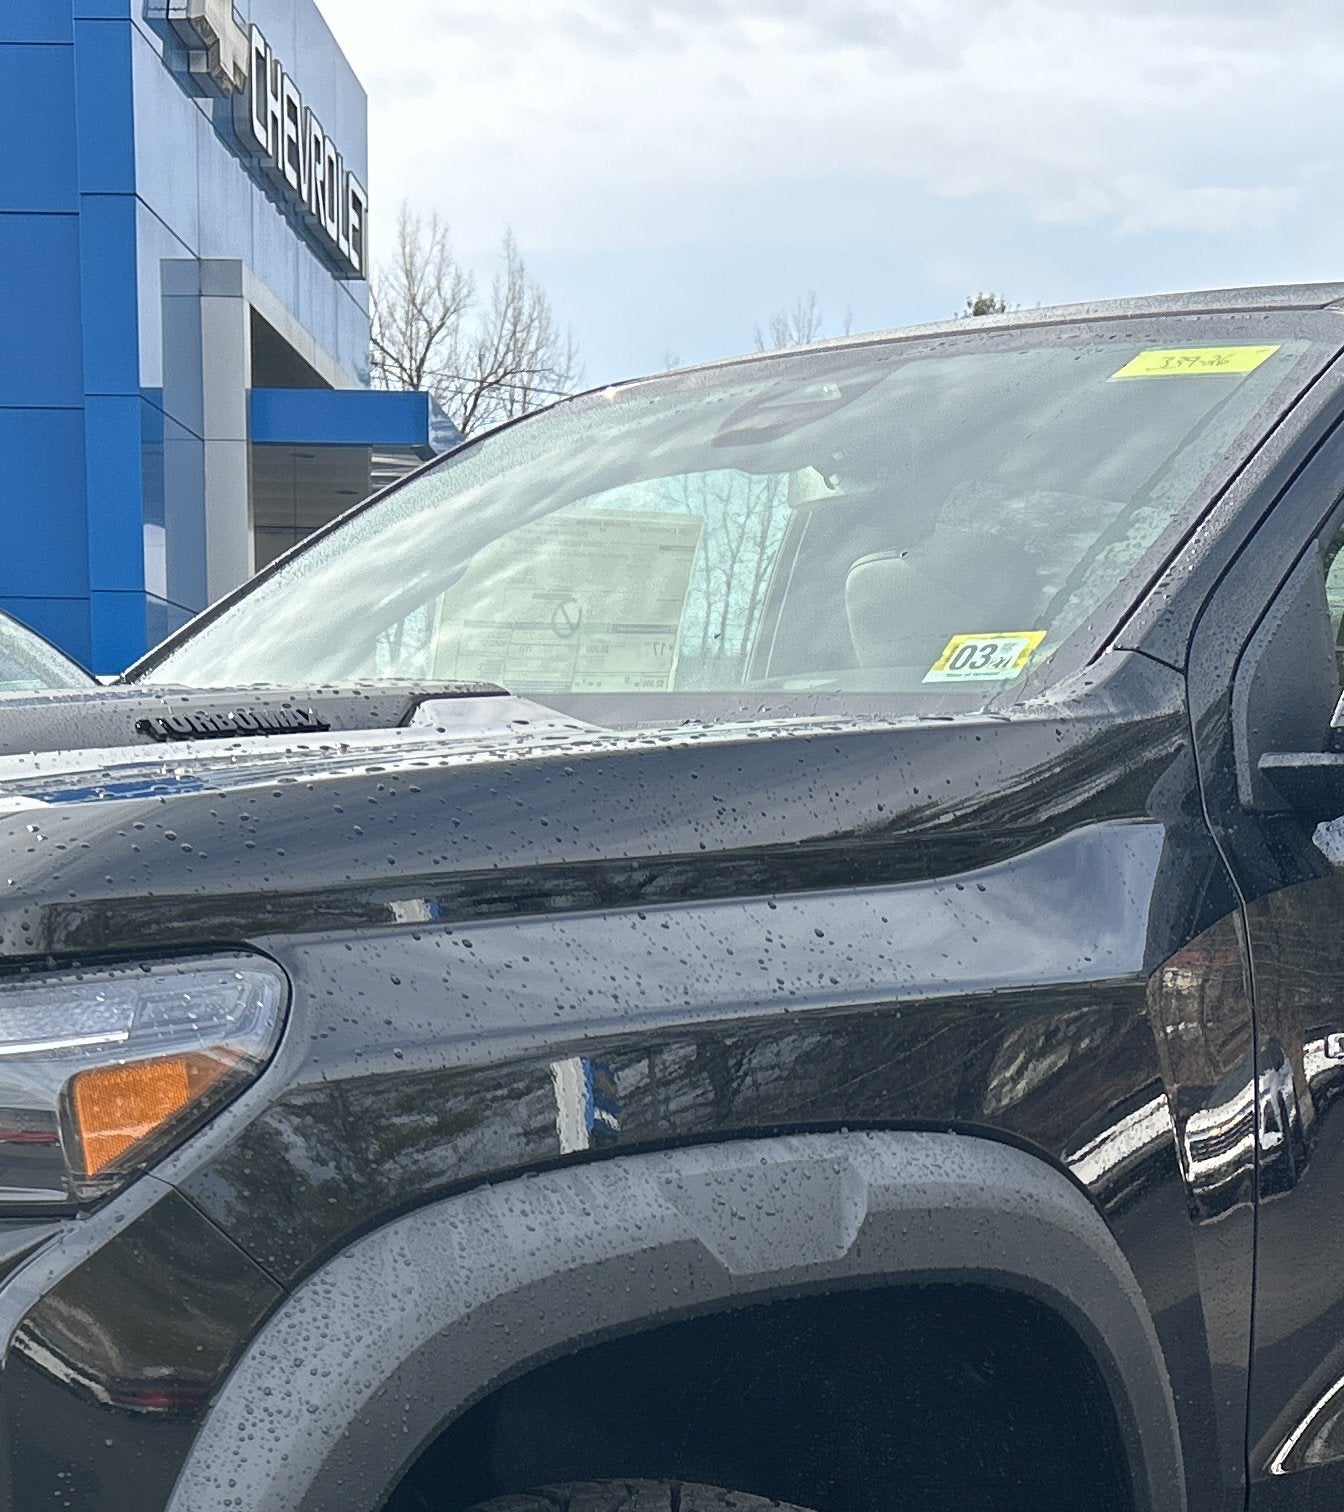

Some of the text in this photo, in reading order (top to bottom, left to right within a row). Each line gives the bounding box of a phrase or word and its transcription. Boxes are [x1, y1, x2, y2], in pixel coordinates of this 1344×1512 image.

[250, 22, 368, 279] CHEVROLET
[949, 643, 999, 671] 03
[135, 707, 331, 741] TURBOMAX
